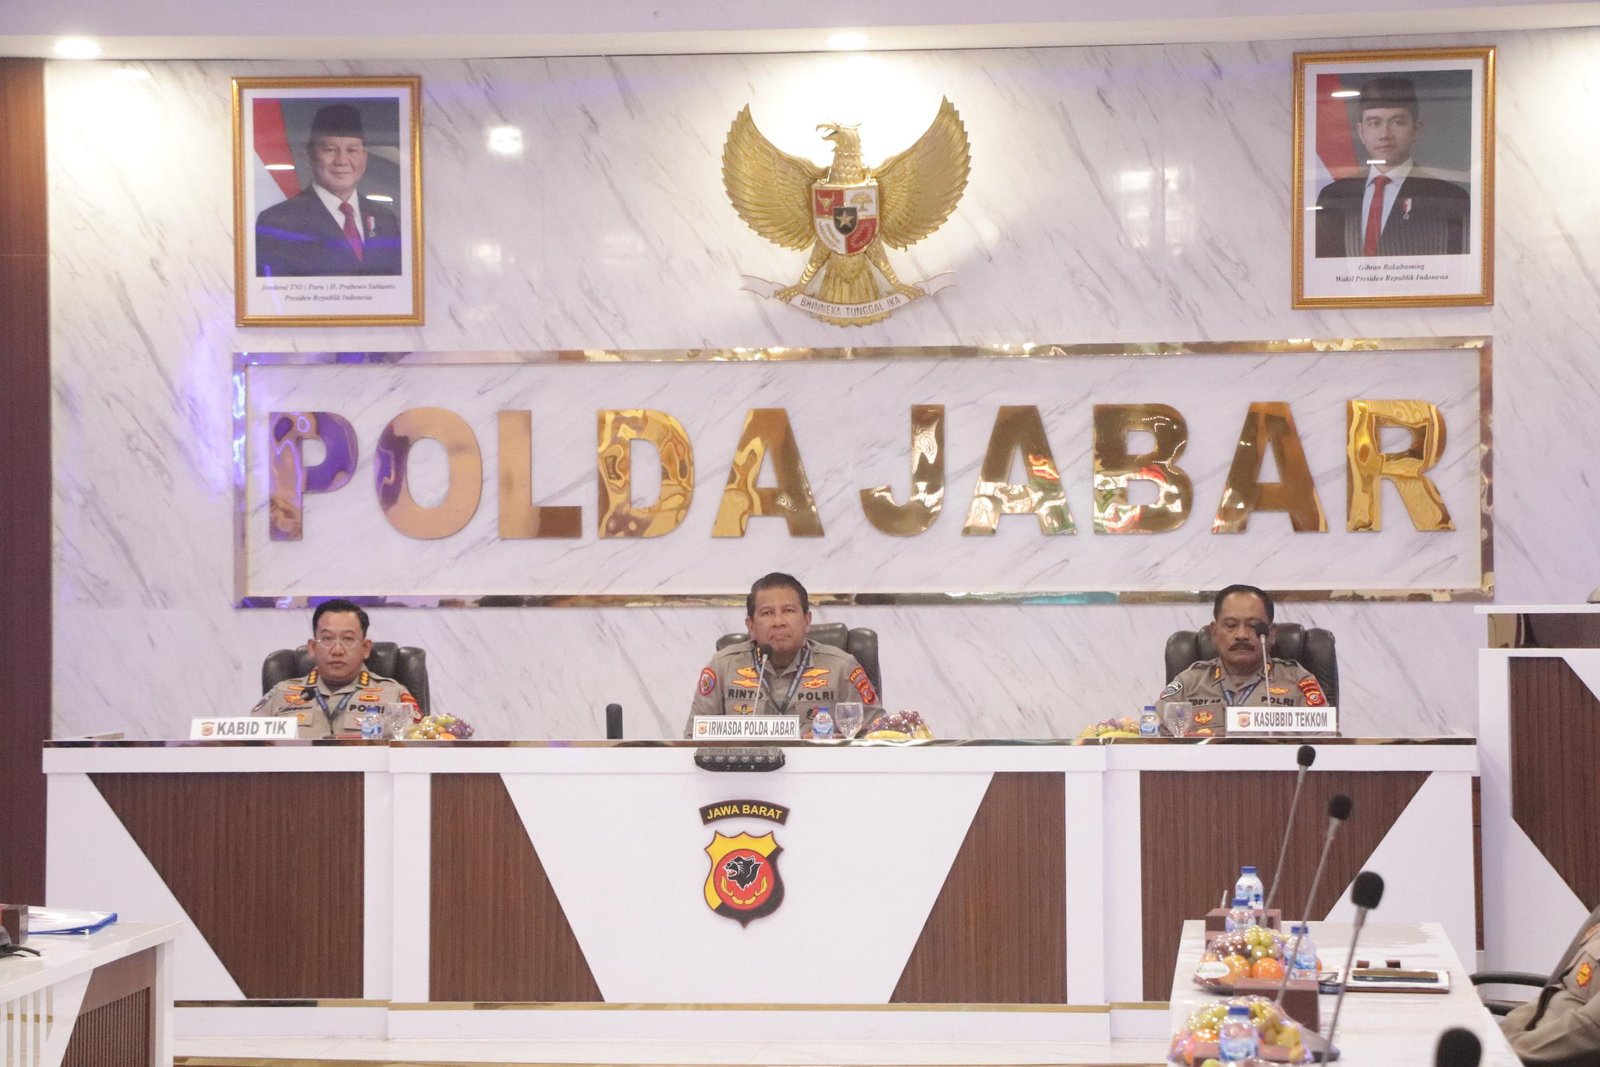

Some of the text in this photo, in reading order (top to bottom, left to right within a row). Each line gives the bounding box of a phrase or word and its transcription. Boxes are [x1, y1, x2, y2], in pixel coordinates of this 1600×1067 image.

[799, 296, 902, 317] BHINNEKA TUNGGAL IKA
[269, 400, 1452, 541] POLDA JABAR
[728, 688, 764, 701] RINTO
[797, 690, 835, 701] POLRI
[1261, 696, 1294, 707] POLRI
[1254, 711, 1328, 728] KASUBBID TEKKOM
[217, 720, 287, 736] KABID TIK
[708, 720, 795, 736] IRWASDA POLDA JABAR
[707, 804, 783, 820] JAWA BARAT
